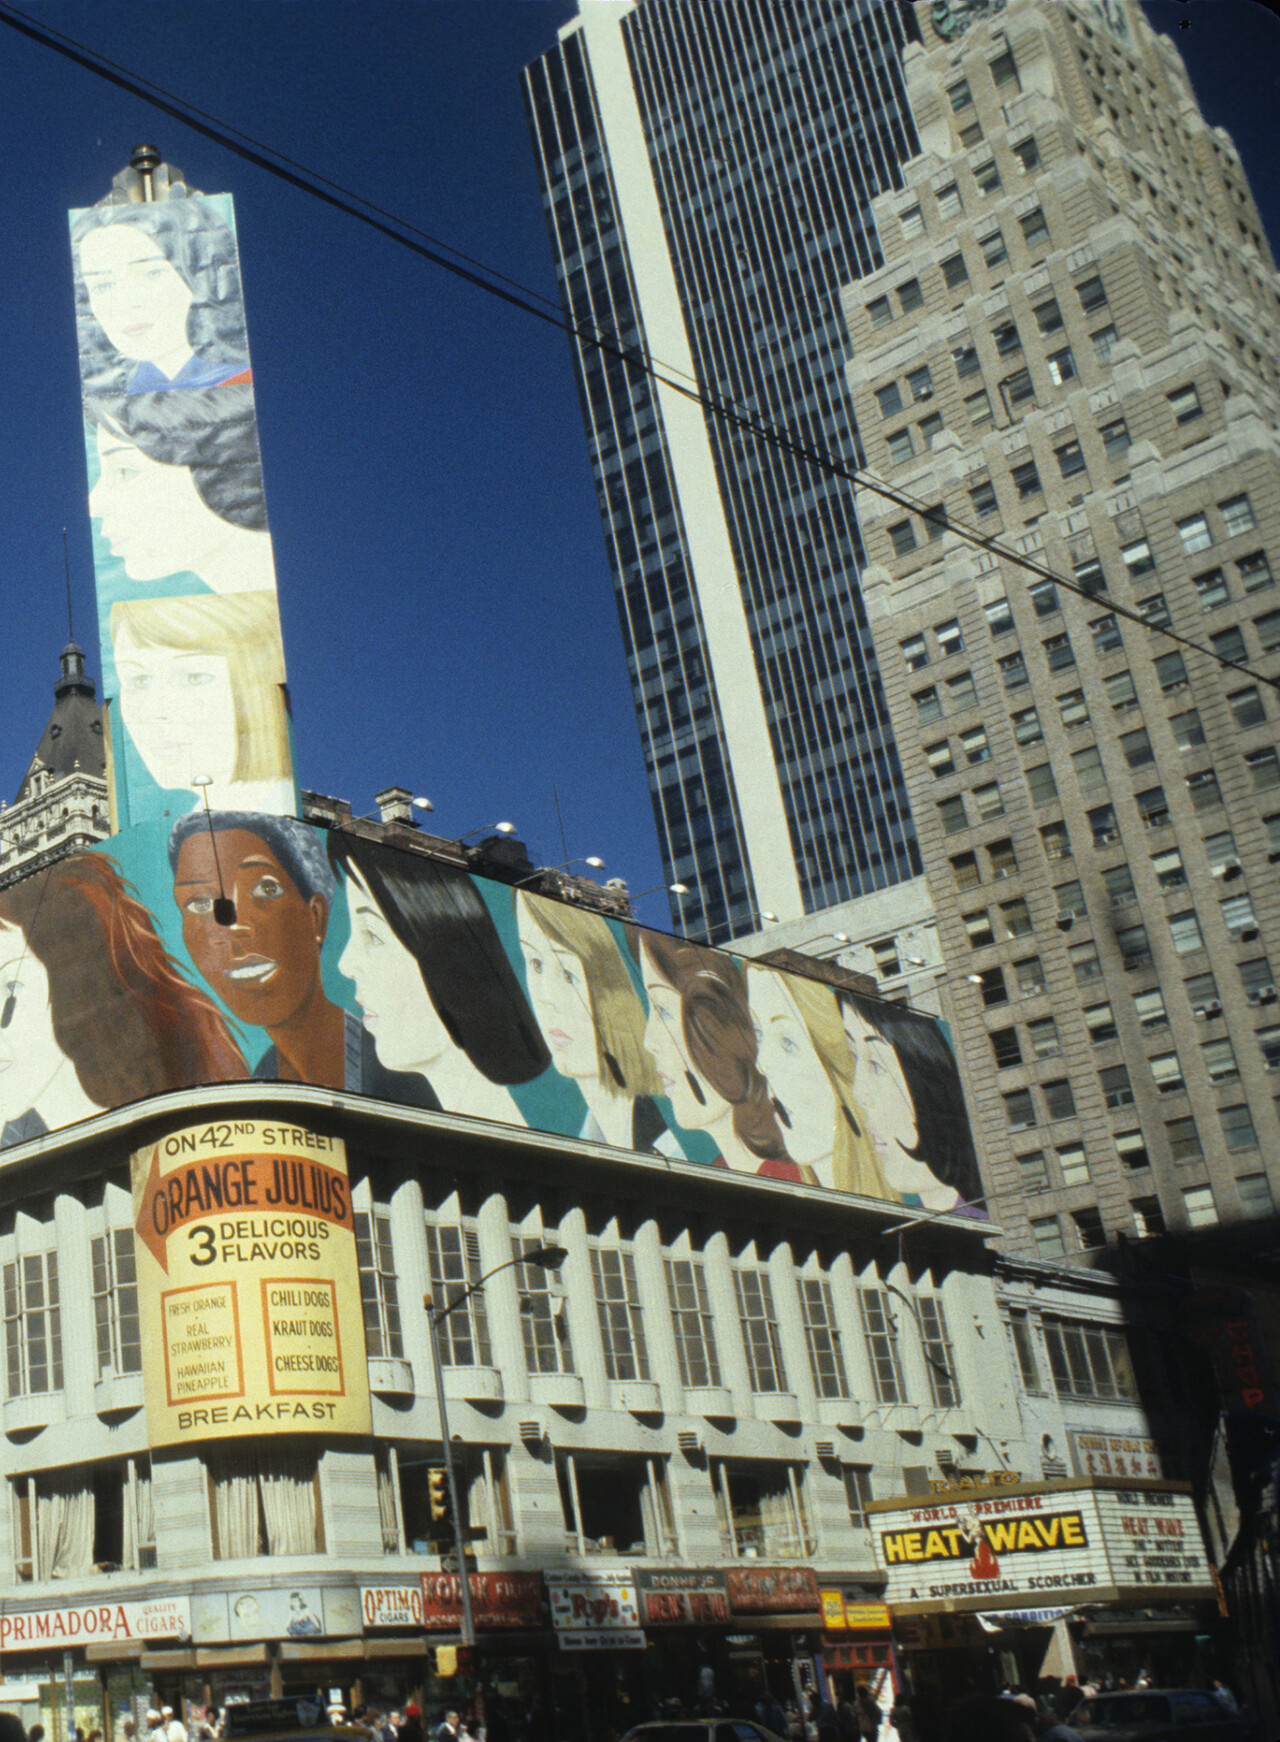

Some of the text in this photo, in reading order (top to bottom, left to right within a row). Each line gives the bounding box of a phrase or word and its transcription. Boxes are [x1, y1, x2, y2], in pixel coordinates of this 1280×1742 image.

[165, 1122, 337, 1157] ON 42ND STREET
[152, 1160, 347, 1236] ORANGE JULIUS
[188, 1219, 330, 1267] 3 DELICIOUS
[222, 1242, 321, 1263] FLAVORS
[168, 1295, 227, 1317] FRESH ORANGE
[271, 1290, 330, 1308] CHILI DOGS
[186, 1323, 209, 1337] REAL
[273, 1320, 333, 1337] KRAUT DOGS
[171, 1335, 232, 1357] STRAWBERRY
[177, 1361, 225, 1380] HAWAIIAN
[275, 1355, 339, 1373] CHEESE DOGS
[177, 1376, 229, 1395] PINEAPPLE
[178, 1402, 337, 1431] BREAKFAST
[928, 1471, 1020, 1494] RIALTO
[911, 1497, 1043, 1523] WORLD PREMIERE
[1121, 1516, 1185, 1538] HEAT WAVE
[885, 1515, 1085, 1563] HEAT WAVE
[910, 1573, 1096, 1599] A SUPERSEXUAL SCORCHER
[142, 1602, 177, 1615] QUALITY
[364, 1588, 422, 1623] OPTIMO
[0, 1605, 132, 1648] PRIMADORA
[136, 1614, 185, 1634] CIGARS
[379, 1611, 410, 1623] CIGARS
